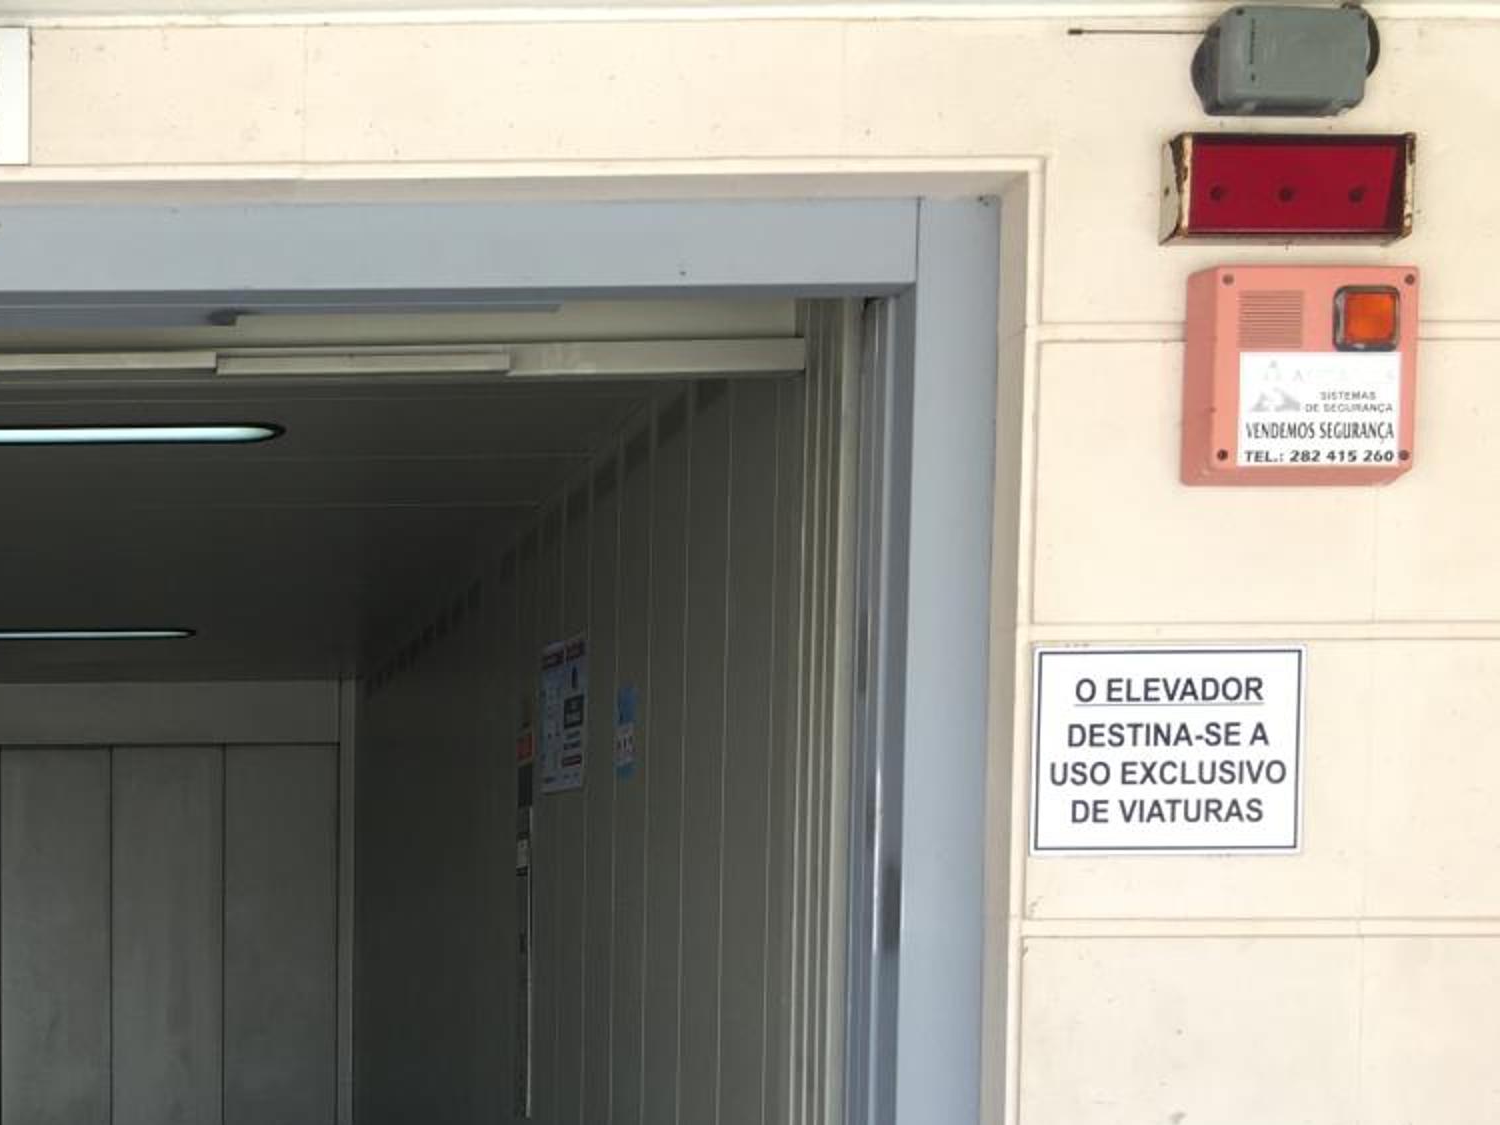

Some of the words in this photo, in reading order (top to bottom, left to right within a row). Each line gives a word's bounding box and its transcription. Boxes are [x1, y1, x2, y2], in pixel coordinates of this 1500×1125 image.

[1320, 391, 1377, 401] SISTEMAS
[1305, 403, 1320, 413] DE
[1245, 422, 1315, 439] VENDEMOS
[1319, 421, 1395, 441] SEGURANÇA
[1289, 449, 1321, 463] 282
[1326, 450, 1357, 463] 415
[1363, 449, 1395, 463] 260
[1075, 678, 1097, 702] O
[1106, 676, 1264, 702] ELEVADOR
[1067, 721, 1242, 748] DESTINA-SE
[1249, 722, 1269, 746] A
[1050, 761, 1111, 786] USO
[1121, 759, 1287, 785] EXCLUSIVO
[1071, 799, 1109, 824] DE
[1118, 797, 1263, 823] VIATURAS
